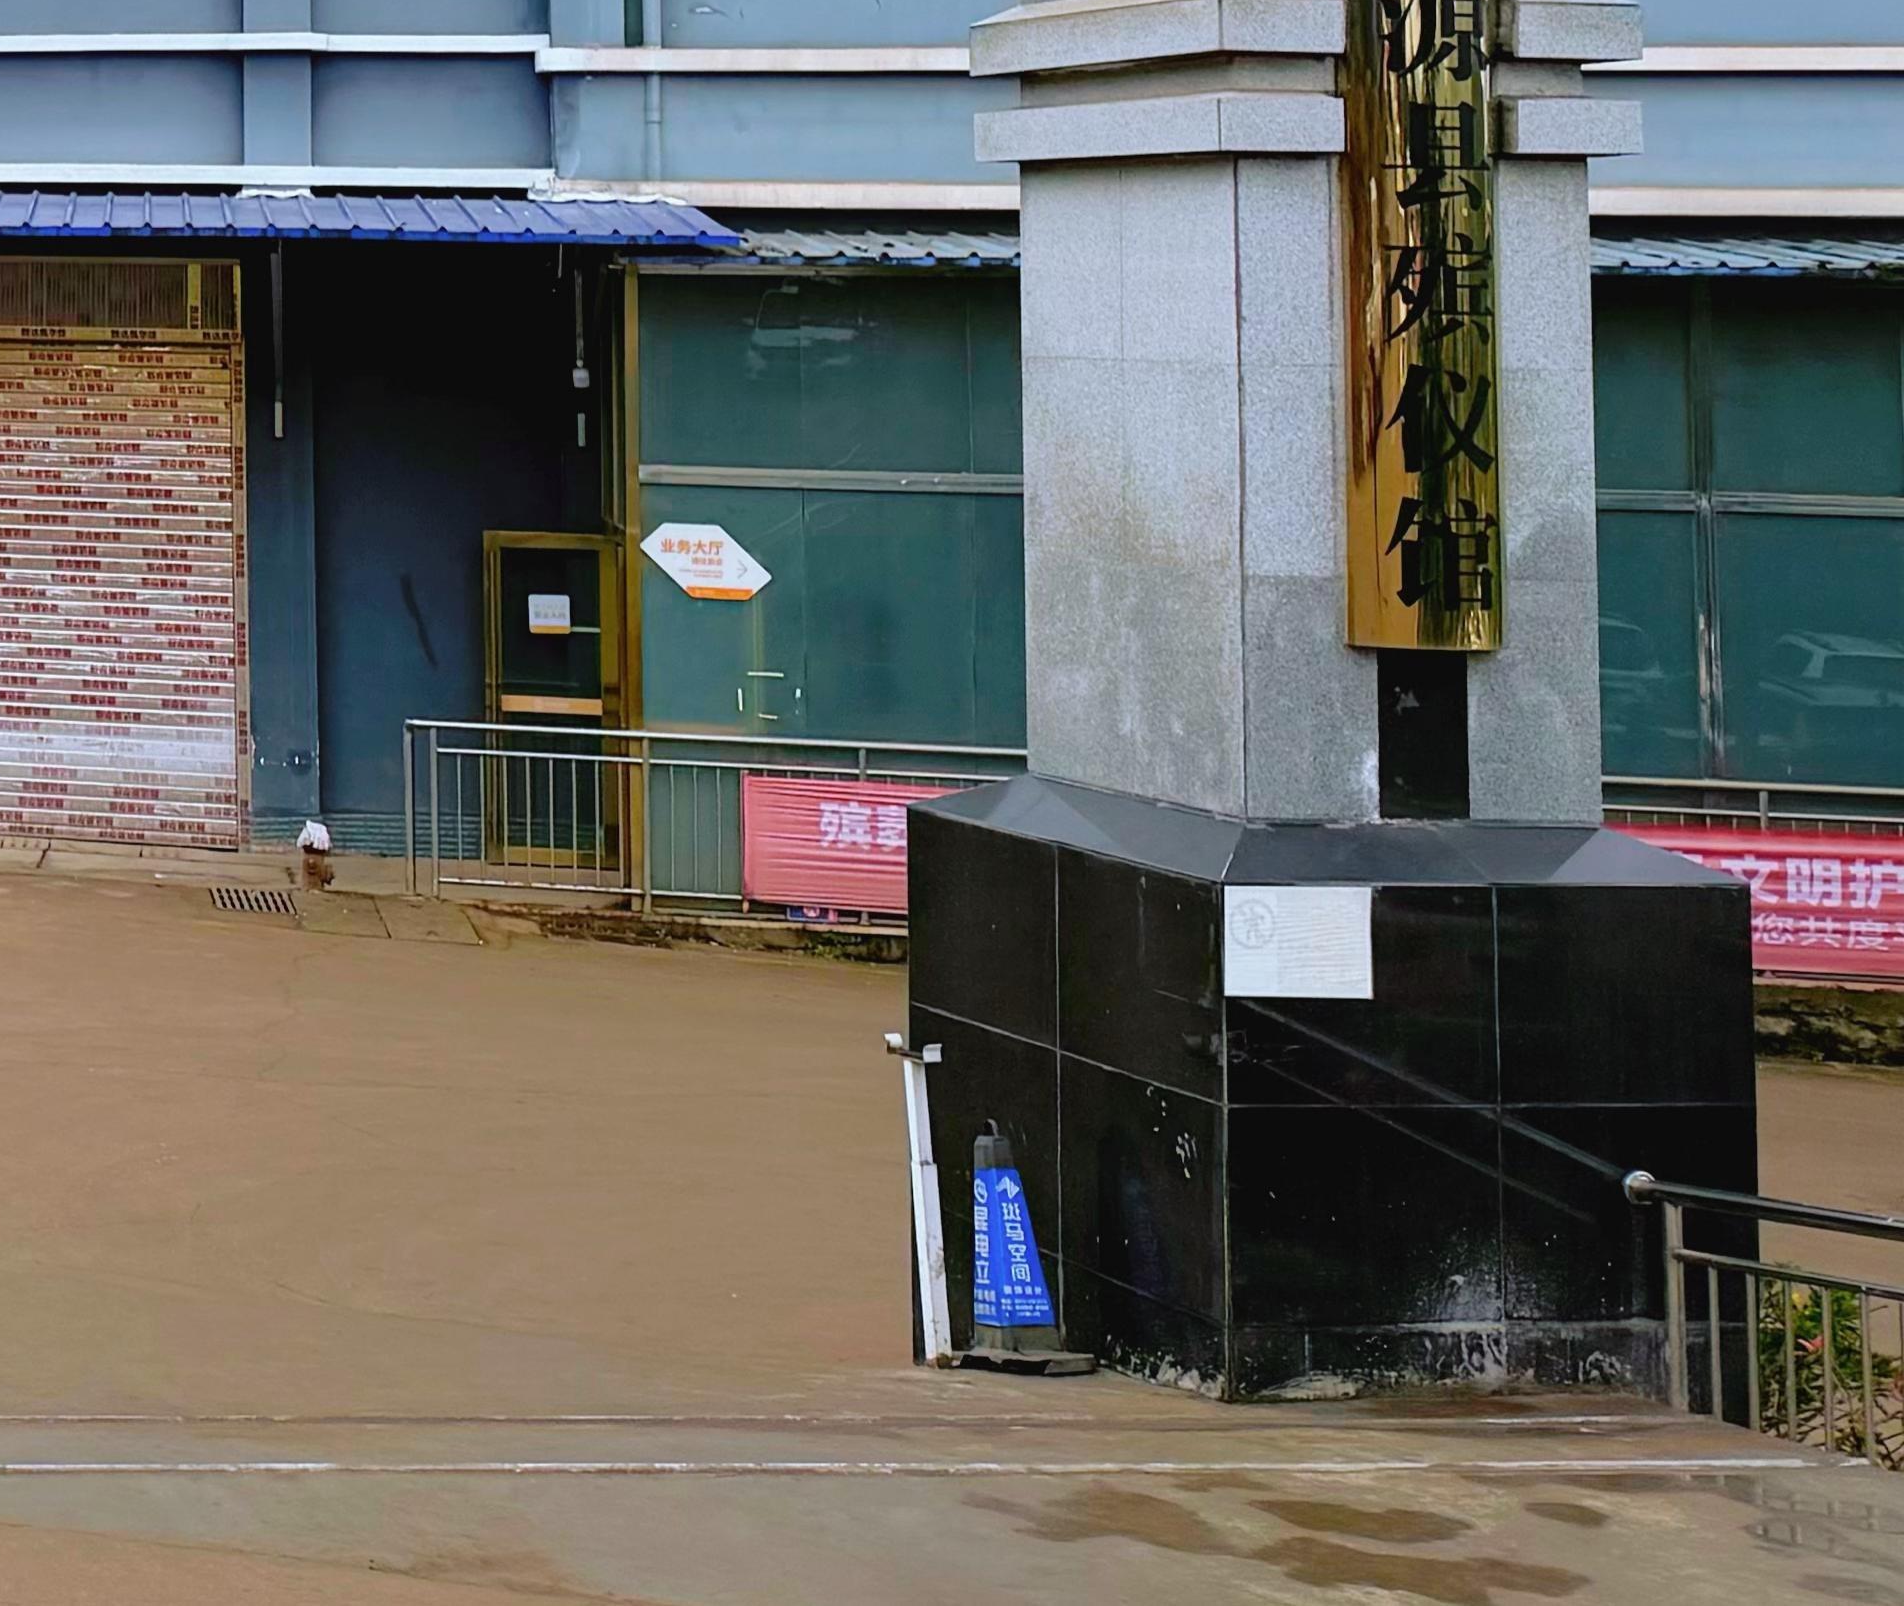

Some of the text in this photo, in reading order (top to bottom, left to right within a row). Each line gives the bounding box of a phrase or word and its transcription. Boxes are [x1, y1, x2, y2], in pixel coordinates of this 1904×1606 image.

[660, 538, 723, 555] 业务大厅
[1752, 912, 1904, 951] 您共度
[1001, 1202, 1031, 1282] 斑马空间
